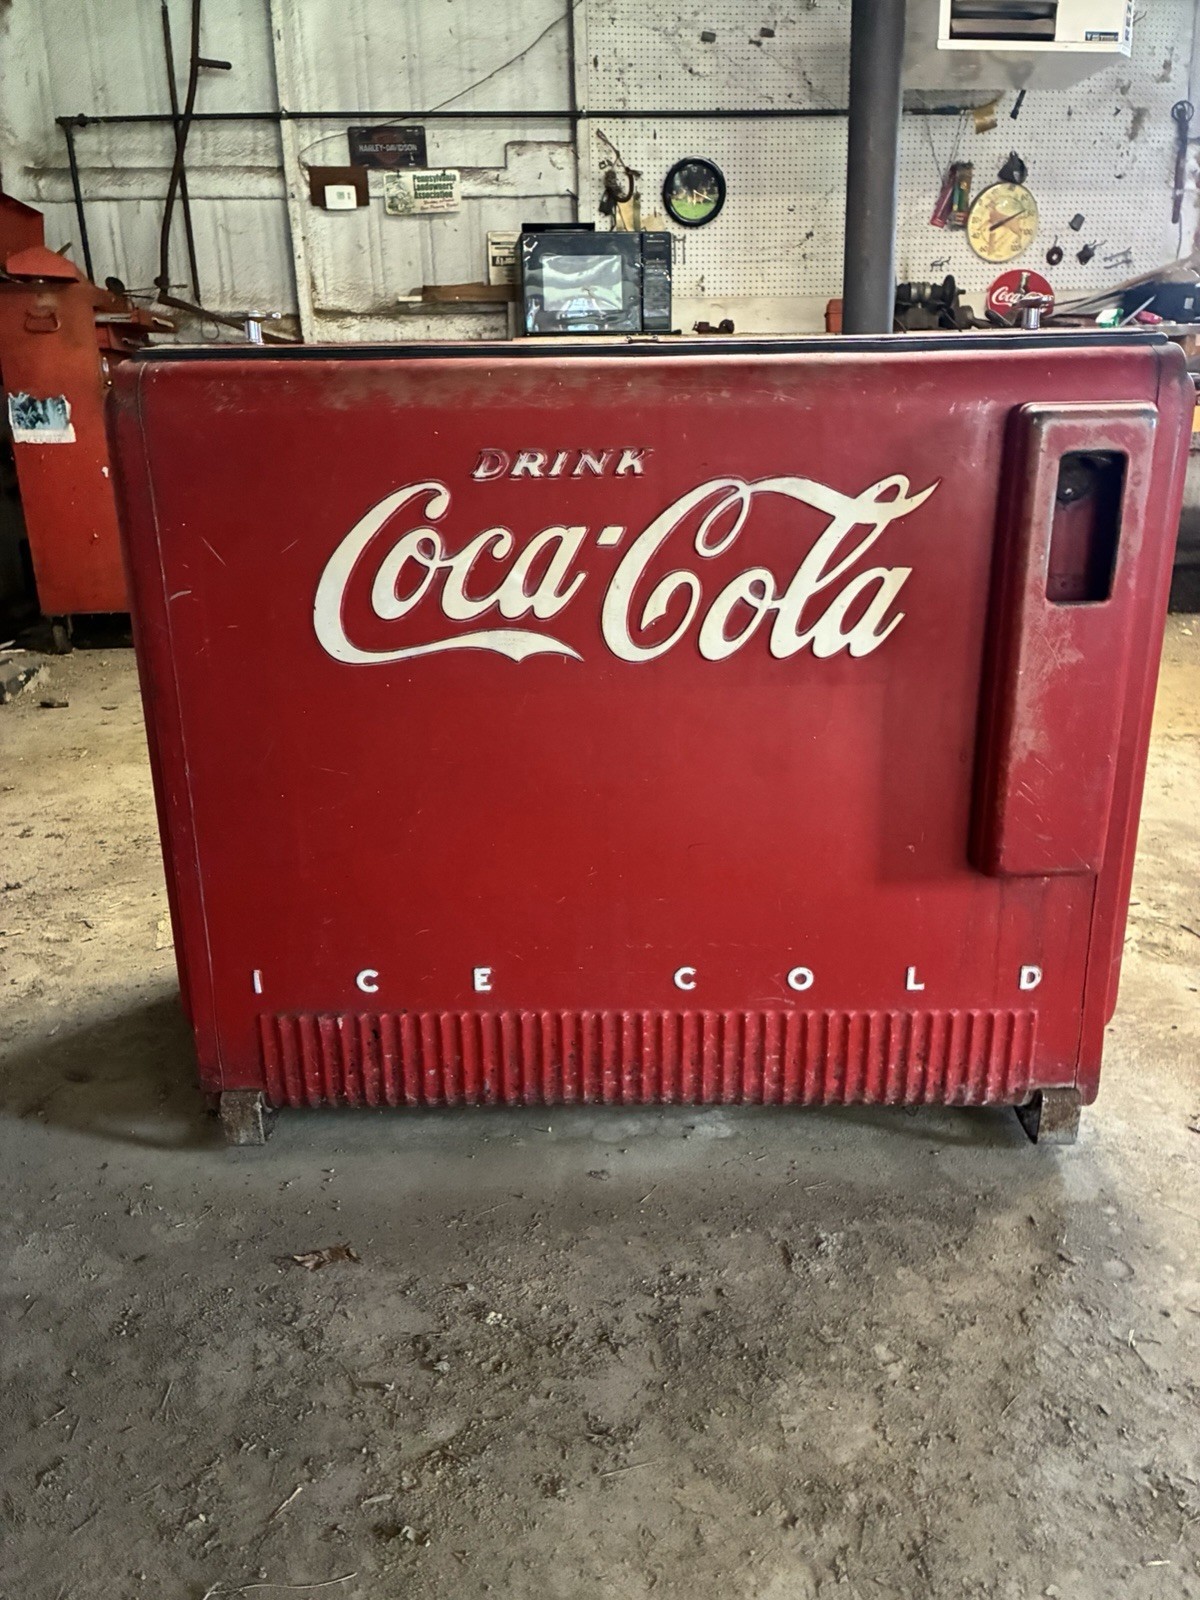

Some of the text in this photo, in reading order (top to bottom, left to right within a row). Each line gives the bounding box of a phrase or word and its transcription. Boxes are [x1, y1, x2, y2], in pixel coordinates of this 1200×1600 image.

[359, 143, 417, 152] HARLEY-DAVIDSON
[414, 190, 453, 199] Association
[470, 447, 653, 481] DRINK
[313, 474, 938, 665] Coca-Cola
